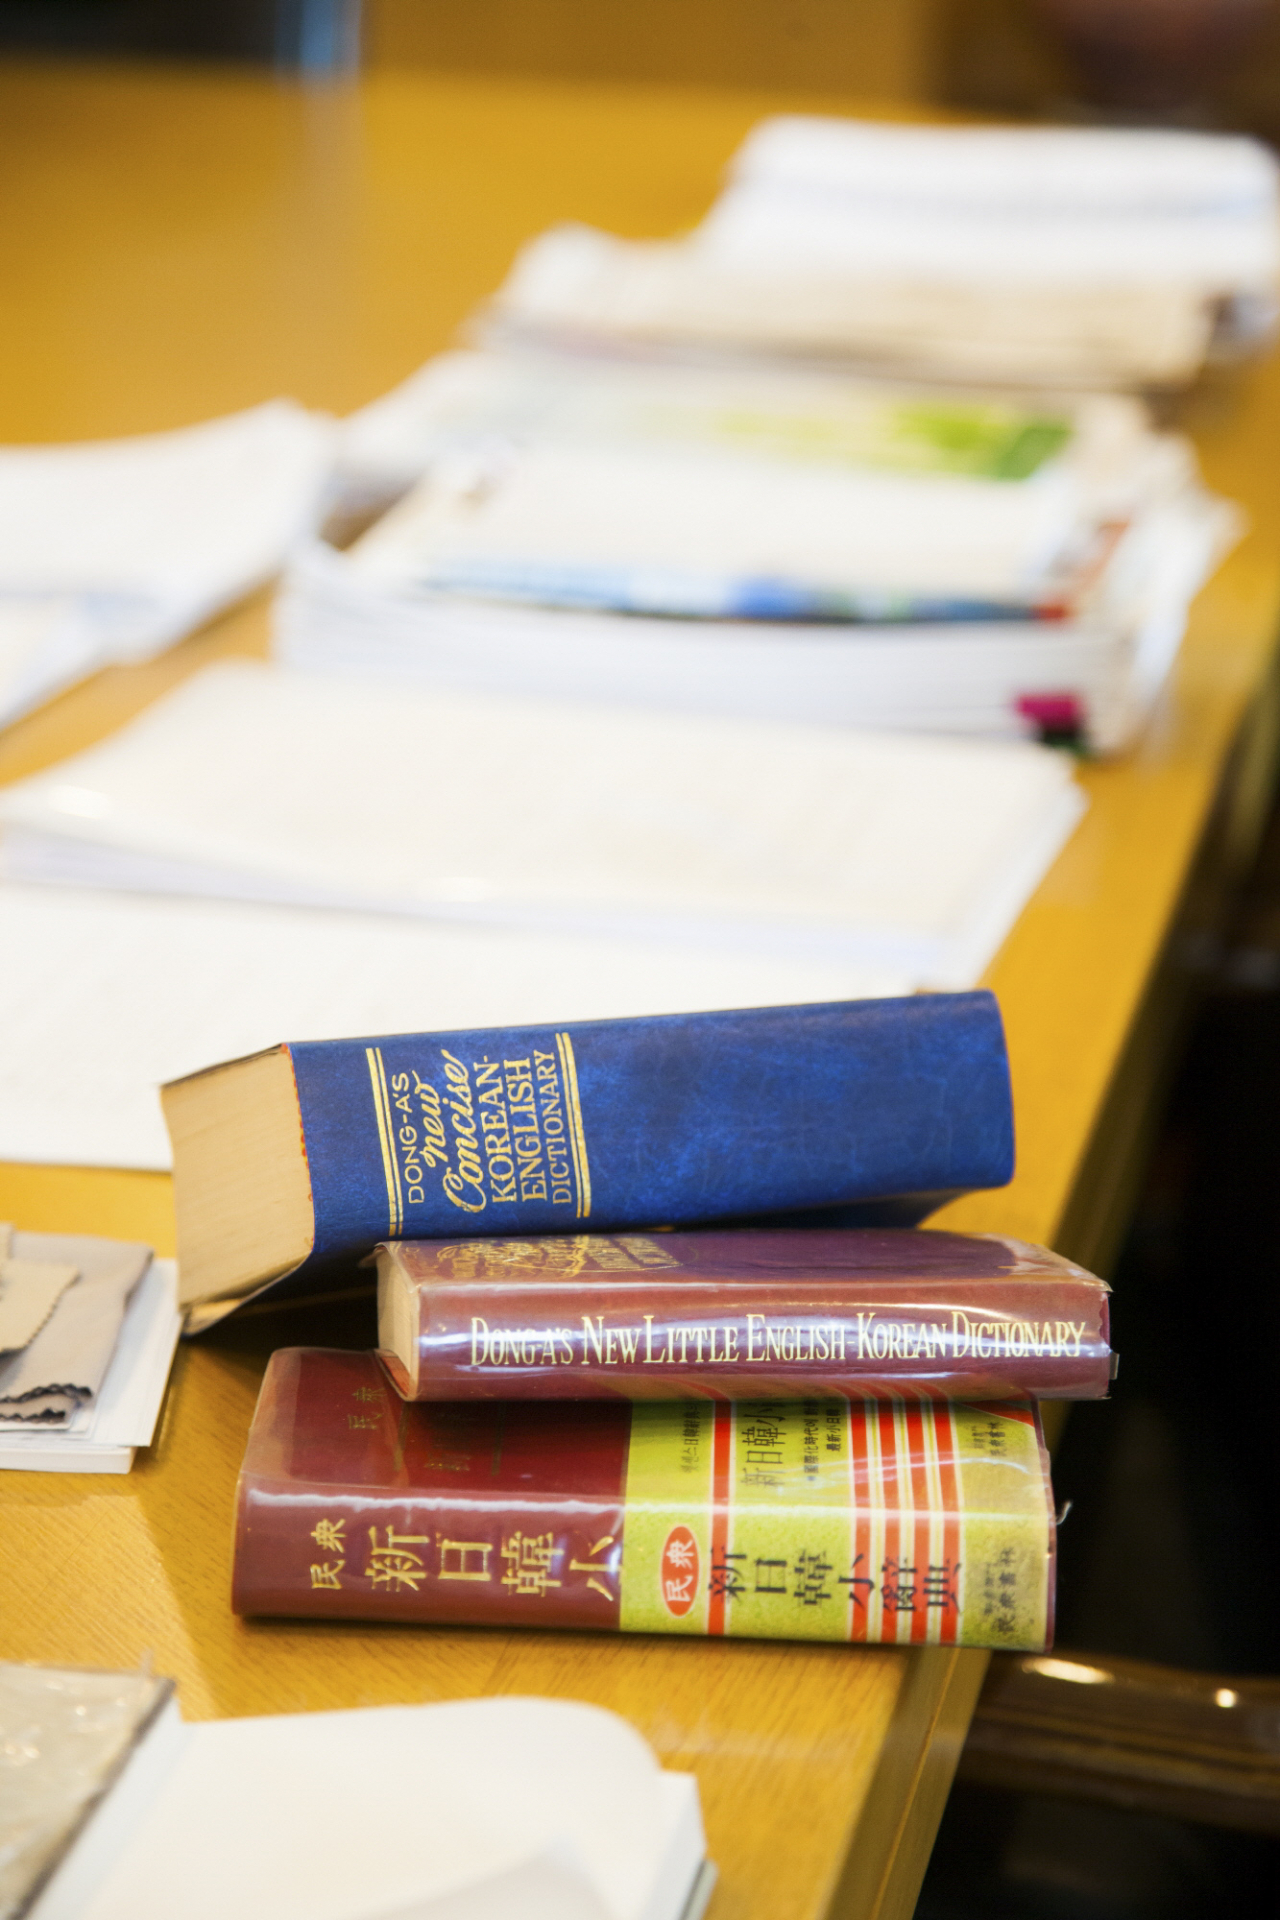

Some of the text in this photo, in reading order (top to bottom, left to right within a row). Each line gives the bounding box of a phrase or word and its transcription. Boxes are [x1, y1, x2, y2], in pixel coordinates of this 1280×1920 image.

[391, 1072, 425, 1204] DONG-A'S
[411, 1069, 449, 1168] new
[441, 1049, 487, 1213] Concise
[473, 1055, 518, 1202] KOREAN-
[503, 1057, 548, 1202] ENGLISH
[533, 1049, 572, 1204] DICTIONARY
[581, 1315, 643, 1365] NEW
[642, 1314, 739, 1363] LITTLE
[951, 1311, 1086, 1358] DICTIONARY
[310, 1518, 347, 1590] 民衆
[664, 1538, 696, 1603] 民衆
[708, 1545, 962, 1612] 新日韓小辭典
